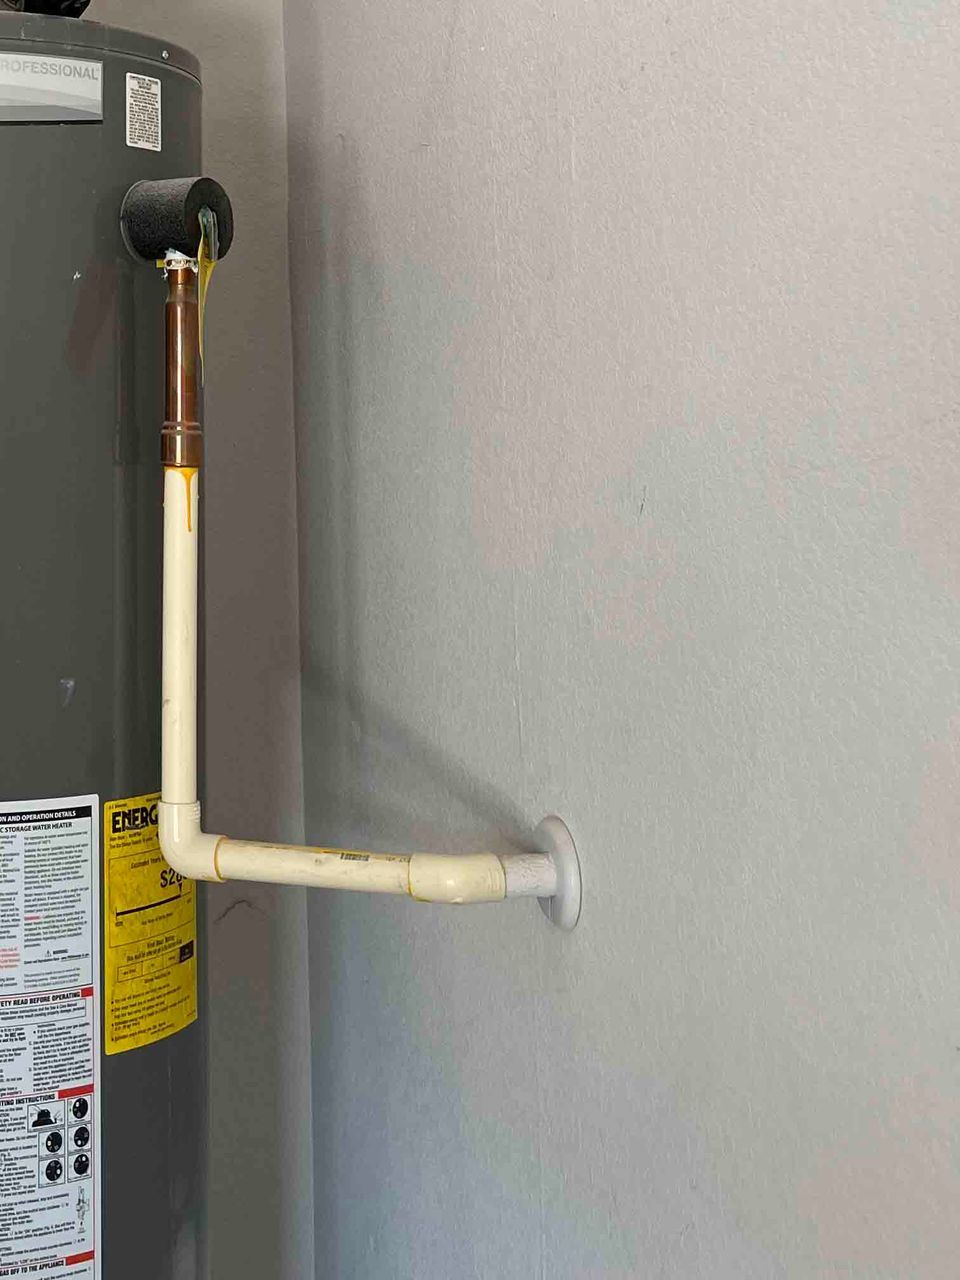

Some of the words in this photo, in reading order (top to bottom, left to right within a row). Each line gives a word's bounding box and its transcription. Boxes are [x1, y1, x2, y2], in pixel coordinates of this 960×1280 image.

[22, 812, 54, 822] OPERATION
[54, 810, 76, 818] DETAILS
[111, 804, 158, 834] ENERG
[4, 825, 32, 833] STORAGE
[32, 823, 51, 831] WATER
[30, 996, 50, 1004] BEFORE
[52, 992, 80, 1002] OPERATING
[16, 1094, 56, 1106] INSTRUCTIONS
[38, 1260, 64, 1270] APPLIANCE
